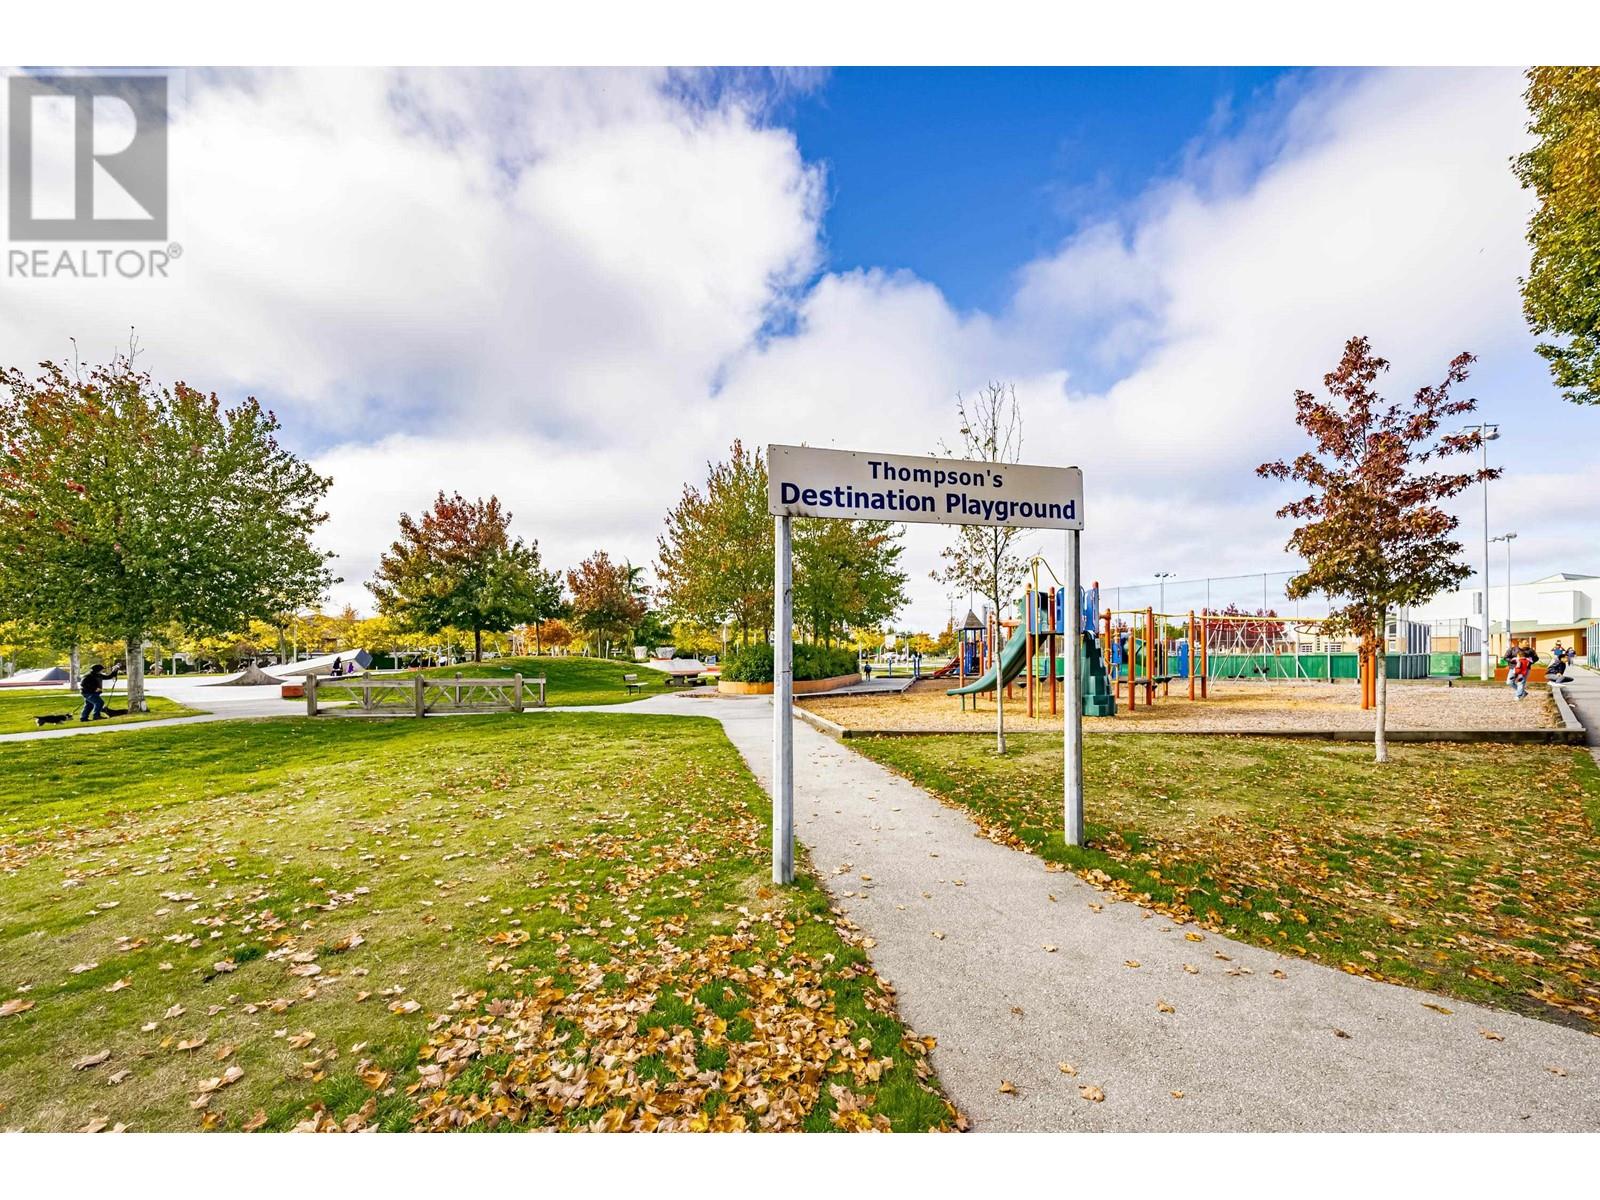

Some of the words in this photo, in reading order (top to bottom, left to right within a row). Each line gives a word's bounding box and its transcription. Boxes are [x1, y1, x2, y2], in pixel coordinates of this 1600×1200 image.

[868, 460, 1003, 488] Thompson's
[781, 482, 936, 513] Destination
[946, 493, 1076, 521] Playground
